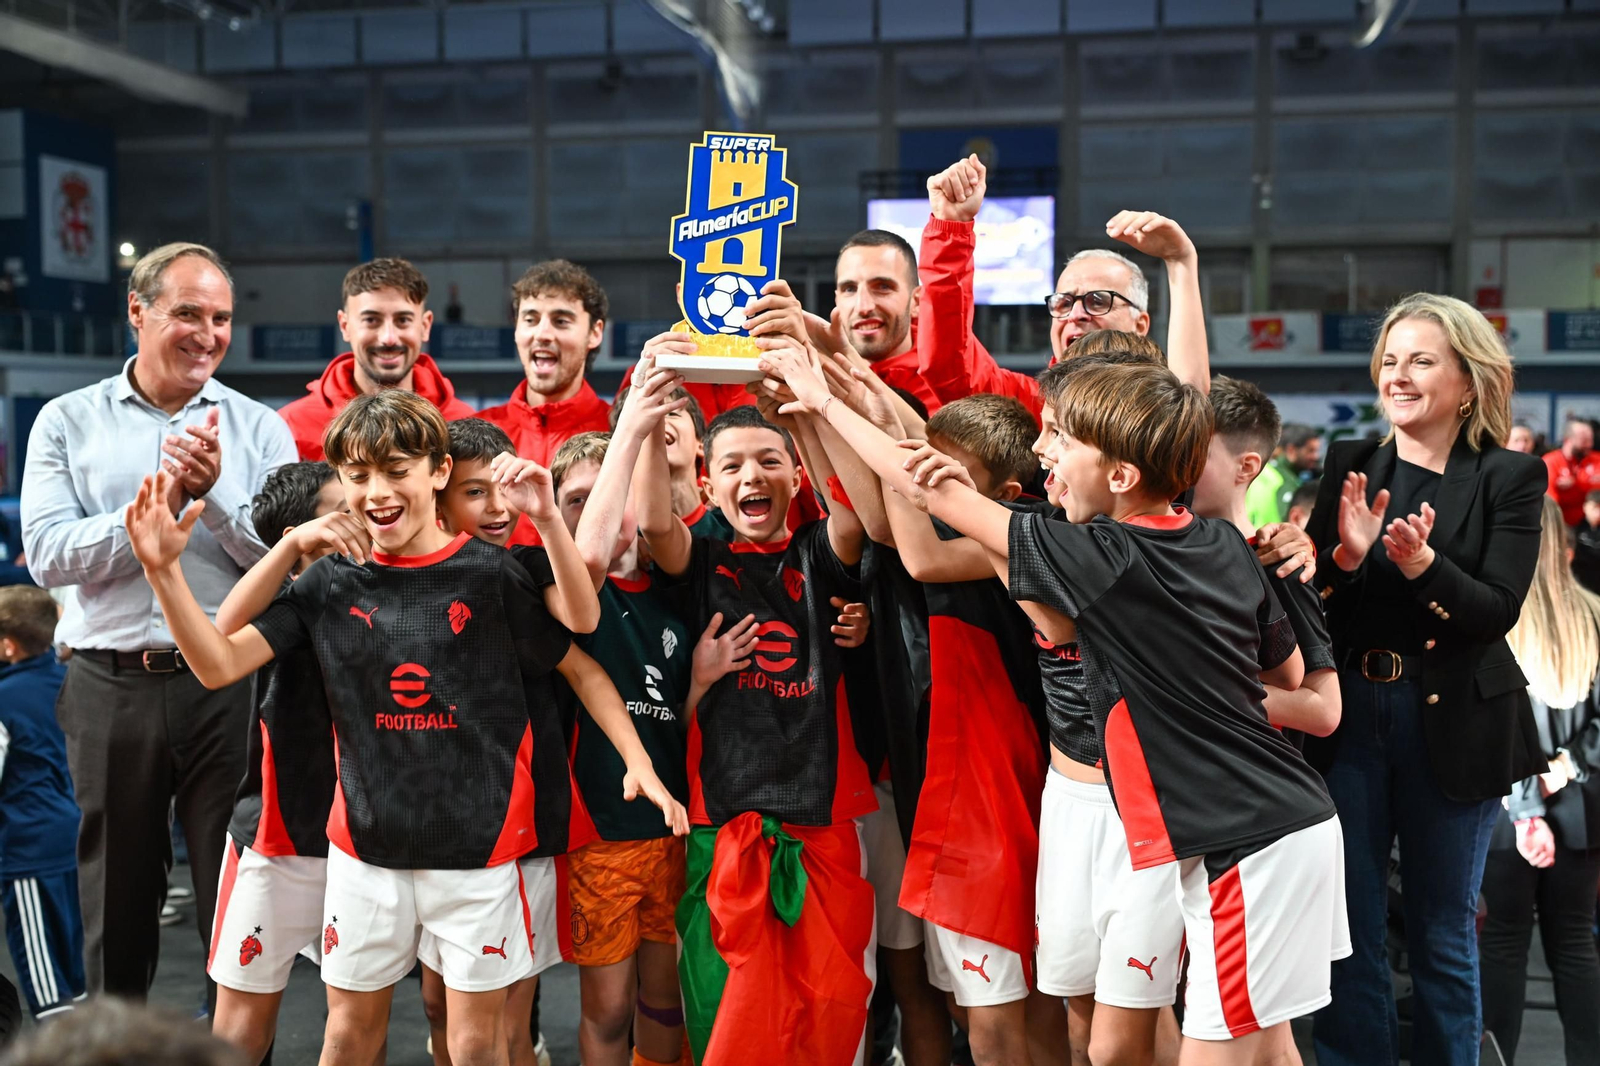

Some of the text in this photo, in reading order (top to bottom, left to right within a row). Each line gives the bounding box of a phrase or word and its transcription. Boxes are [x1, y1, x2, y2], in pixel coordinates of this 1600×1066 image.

[709, 137, 771, 151] SUPER
[738, 671, 815, 698] FOOTBALL
[626, 701, 676, 721] FOOTBA
[375, 713, 458, 730] FOOTBALL
